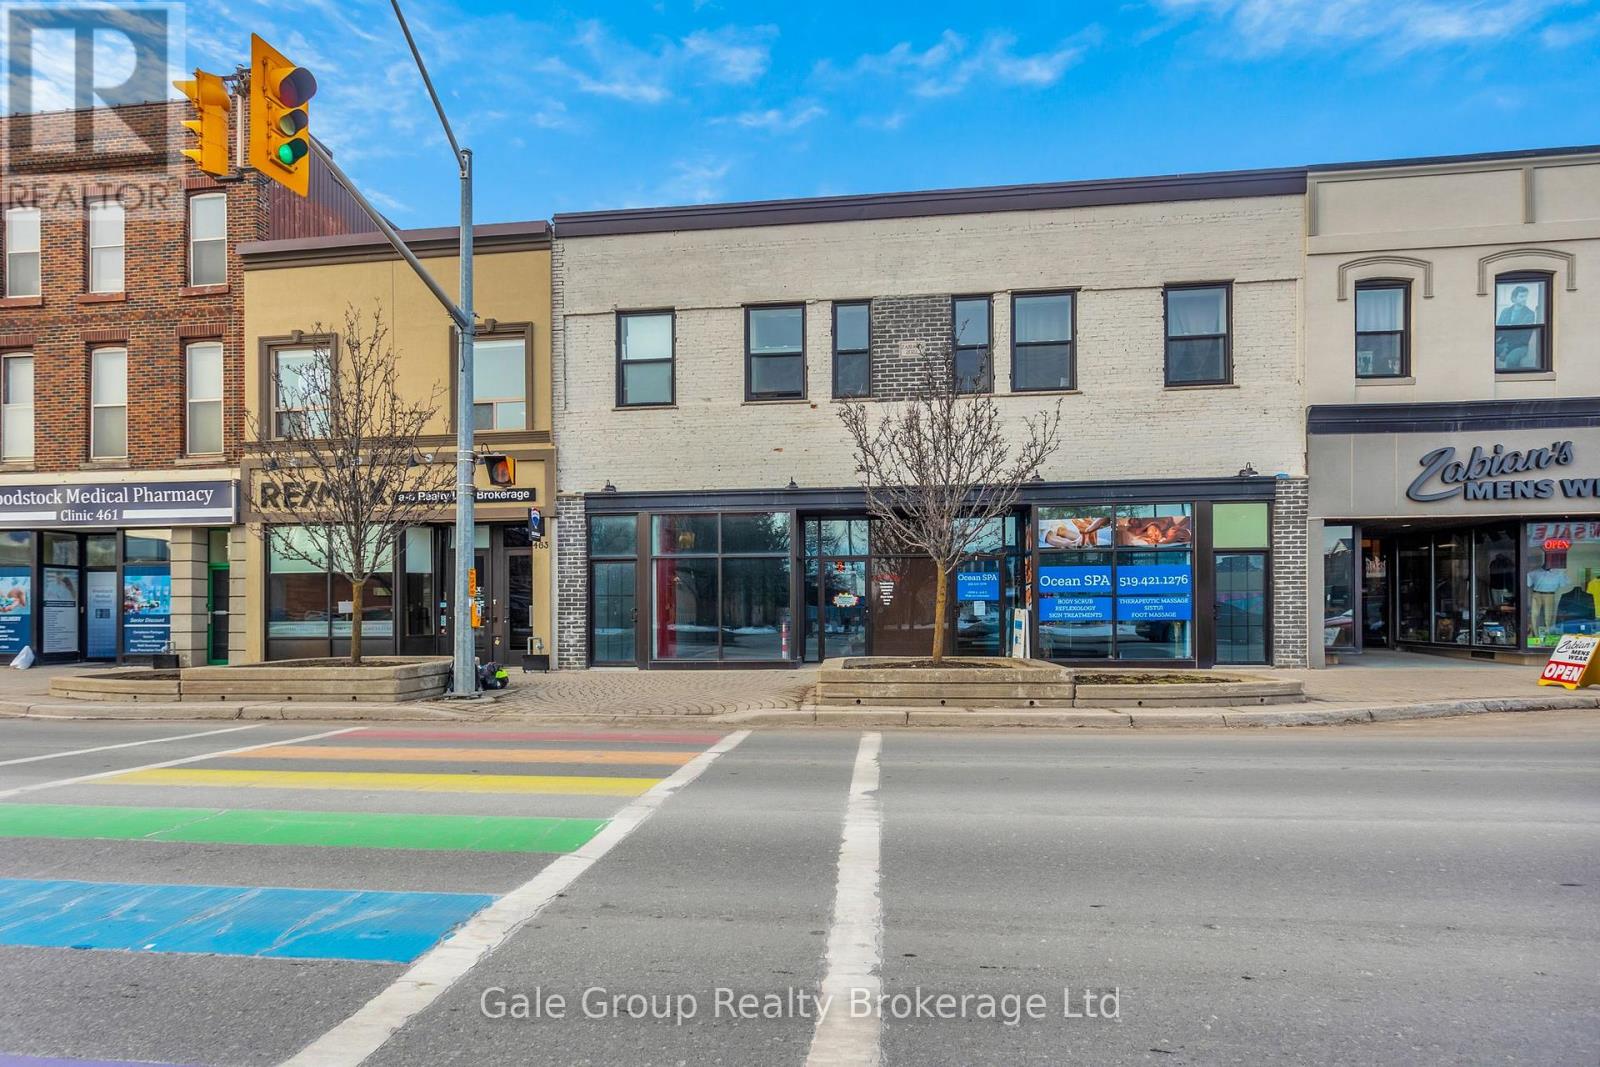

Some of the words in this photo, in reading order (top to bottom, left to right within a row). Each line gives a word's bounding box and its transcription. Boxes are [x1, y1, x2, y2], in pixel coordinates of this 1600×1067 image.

[1406, 440, 1574, 502] Zabian's
[476, 489, 530, 500] Brokerage
[1464, 478, 1555, 500] MENS
[1559, 478, 1600, 498] W
[66, 487, 129, 504] Medical
[133, 486, 213, 506] Pharmacy
[60, 510, 93, 522] Clinic
[96, 509, 119, 521] 461
[1544, 539, 1569, 550] OPEN
[982, 573, 997, 581] SPA
[1040, 575, 1081, 587] Ocean
[1084, 574, 1111, 586] SPA
[1119, 574, 1188, 587] 519.421.1276
[1544, 663, 1584, 682] OPEN
